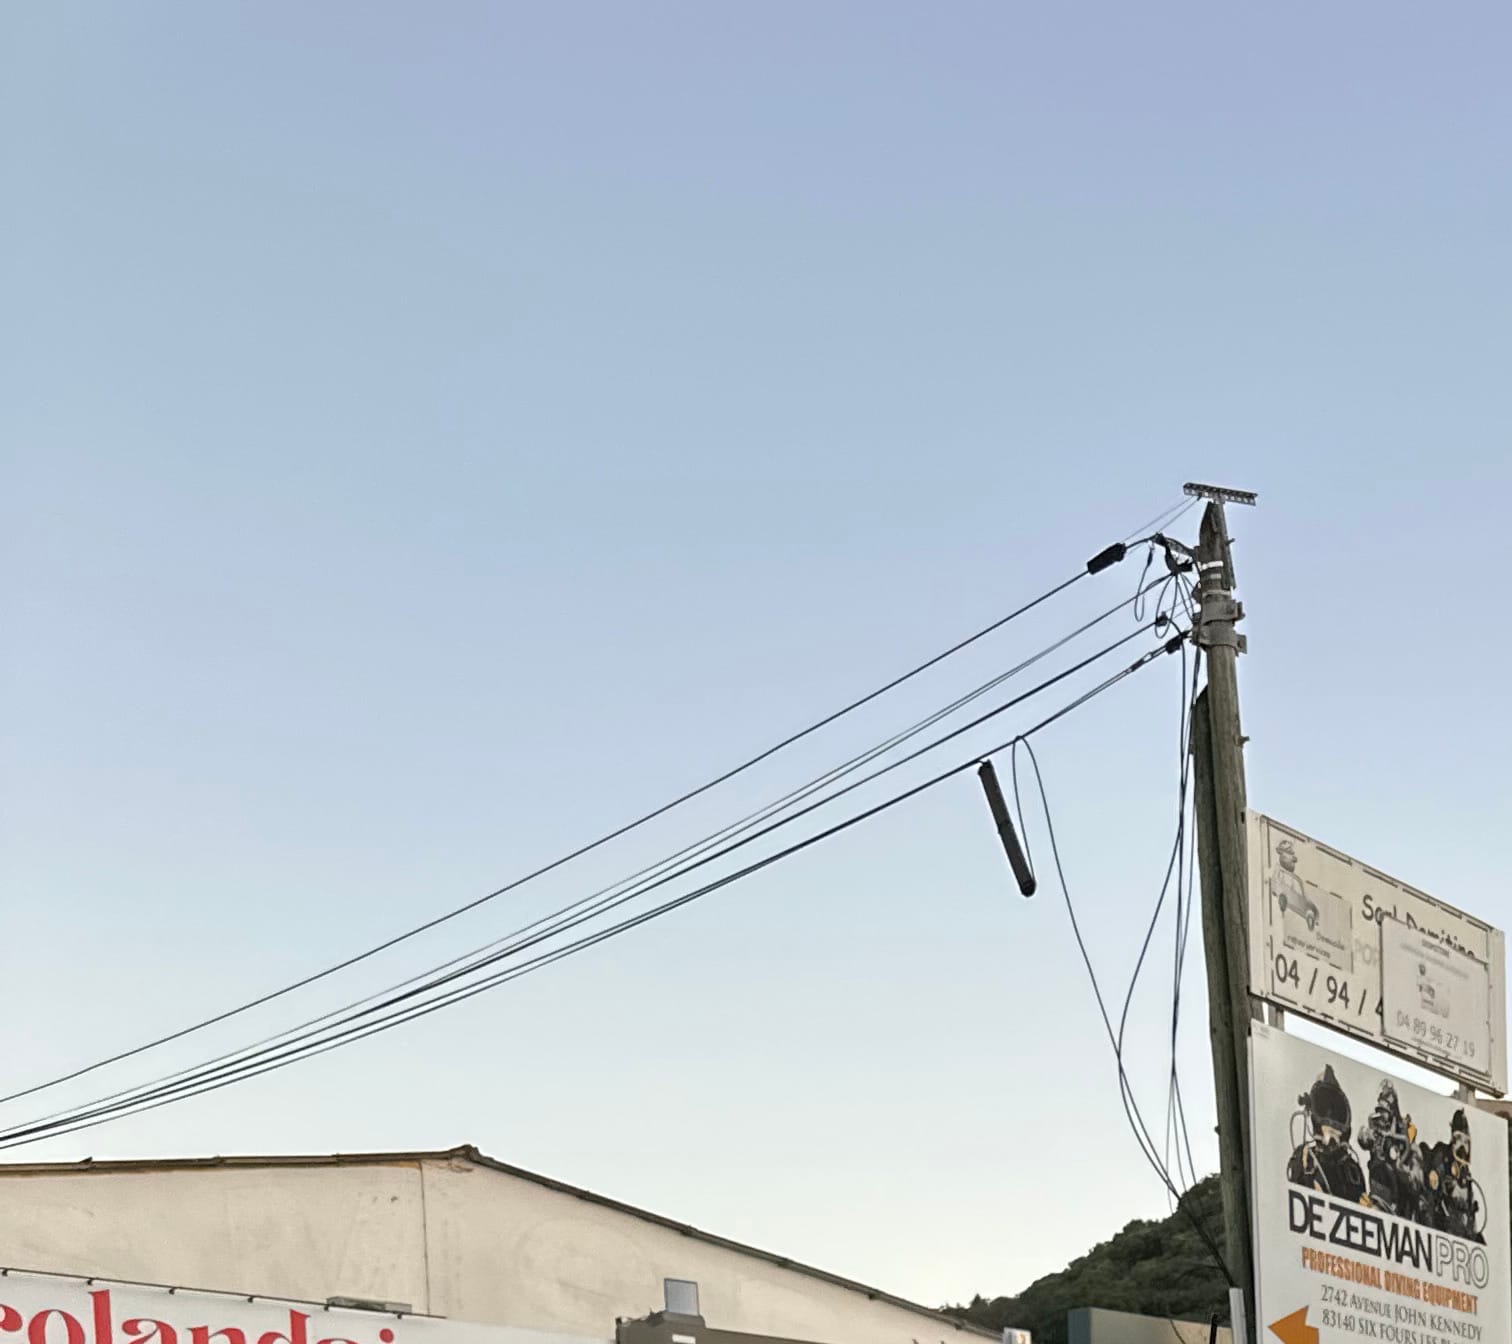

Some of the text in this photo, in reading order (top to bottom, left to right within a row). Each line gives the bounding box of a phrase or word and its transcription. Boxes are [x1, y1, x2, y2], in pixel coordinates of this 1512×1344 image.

[1275, 953, 1300, 989] 04
[1326, 975, 1350, 1009] 94
[1302, 1246, 1479, 1315] PROFESSIONAL DIVING EQUIPMENT
[1321, 1285, 1483, 1342] 2742 AVENUE JOHN KENNEDY
[1322, 1308, 1355, 1332] 83140
[1358, 1318, 1377, 1338] SIX
